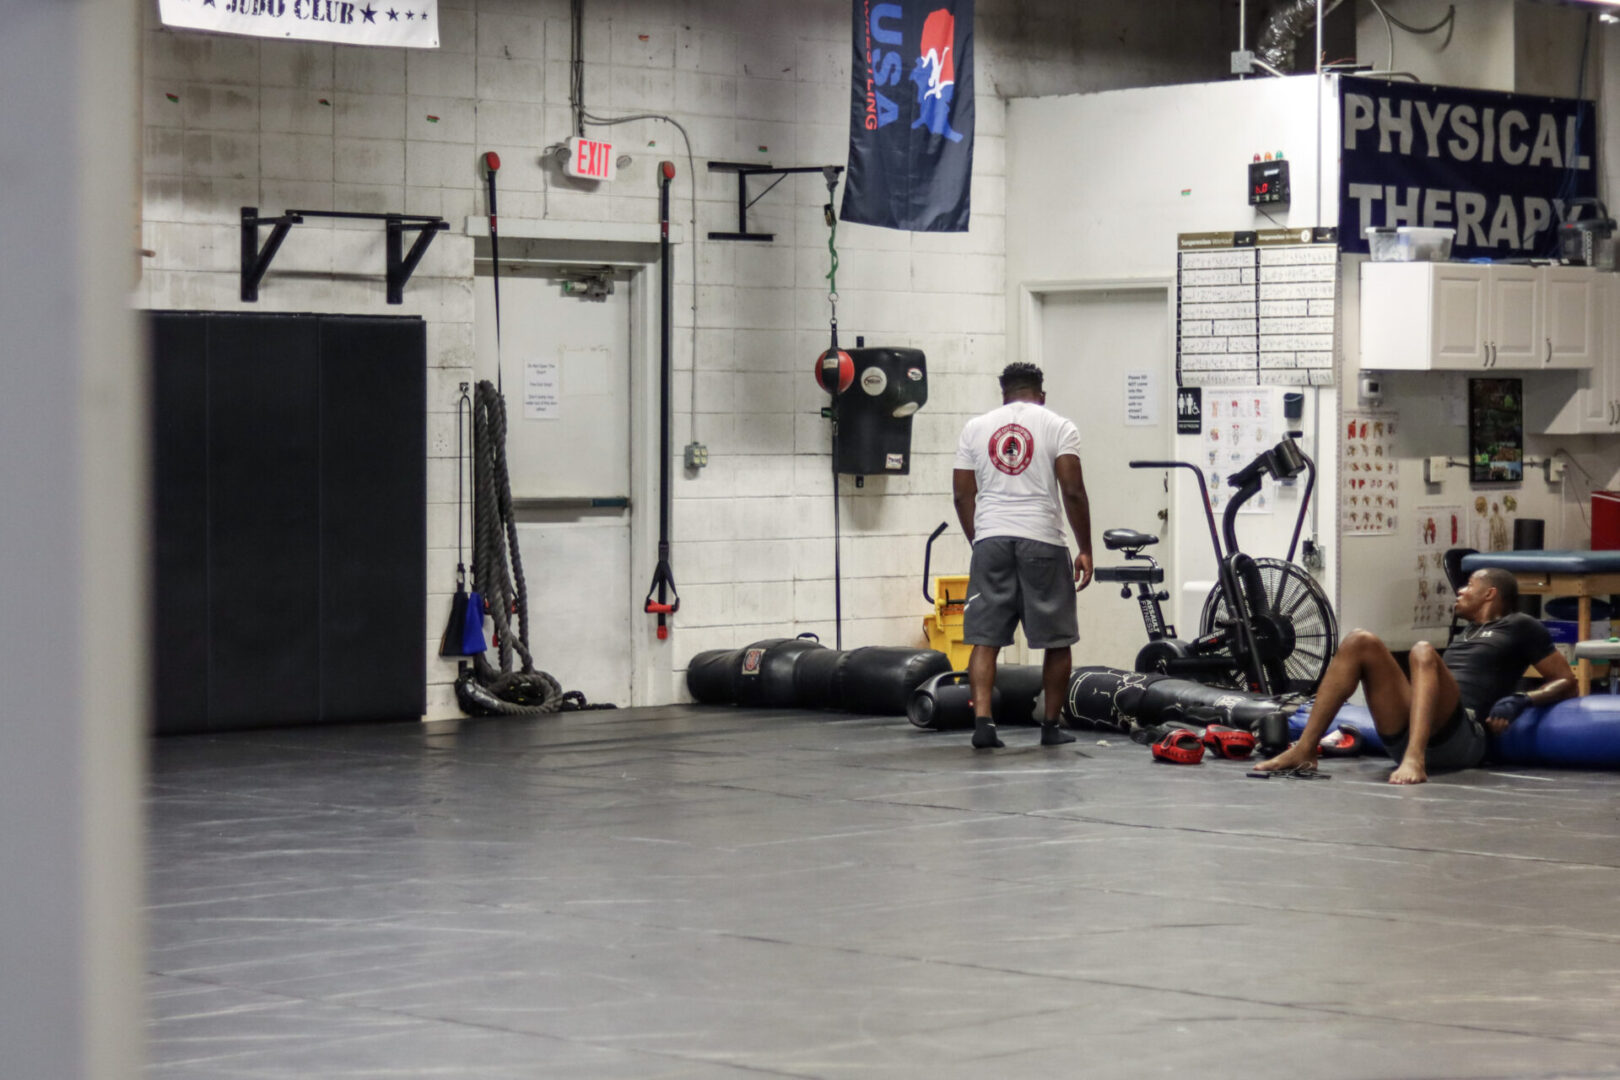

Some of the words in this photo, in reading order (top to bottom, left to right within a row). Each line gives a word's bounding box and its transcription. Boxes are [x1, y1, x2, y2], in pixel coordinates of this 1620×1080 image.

[226, 0, 286, 18] JUDO
[294, 0, 354, 25] CLUB
[870, 3, 904, 129] USA
[1344, 93, 1591, 171] PHYSICAL
[577, 139, 612, 178] EXIT
[1146, 599, 1160, 633] ASSAULT
